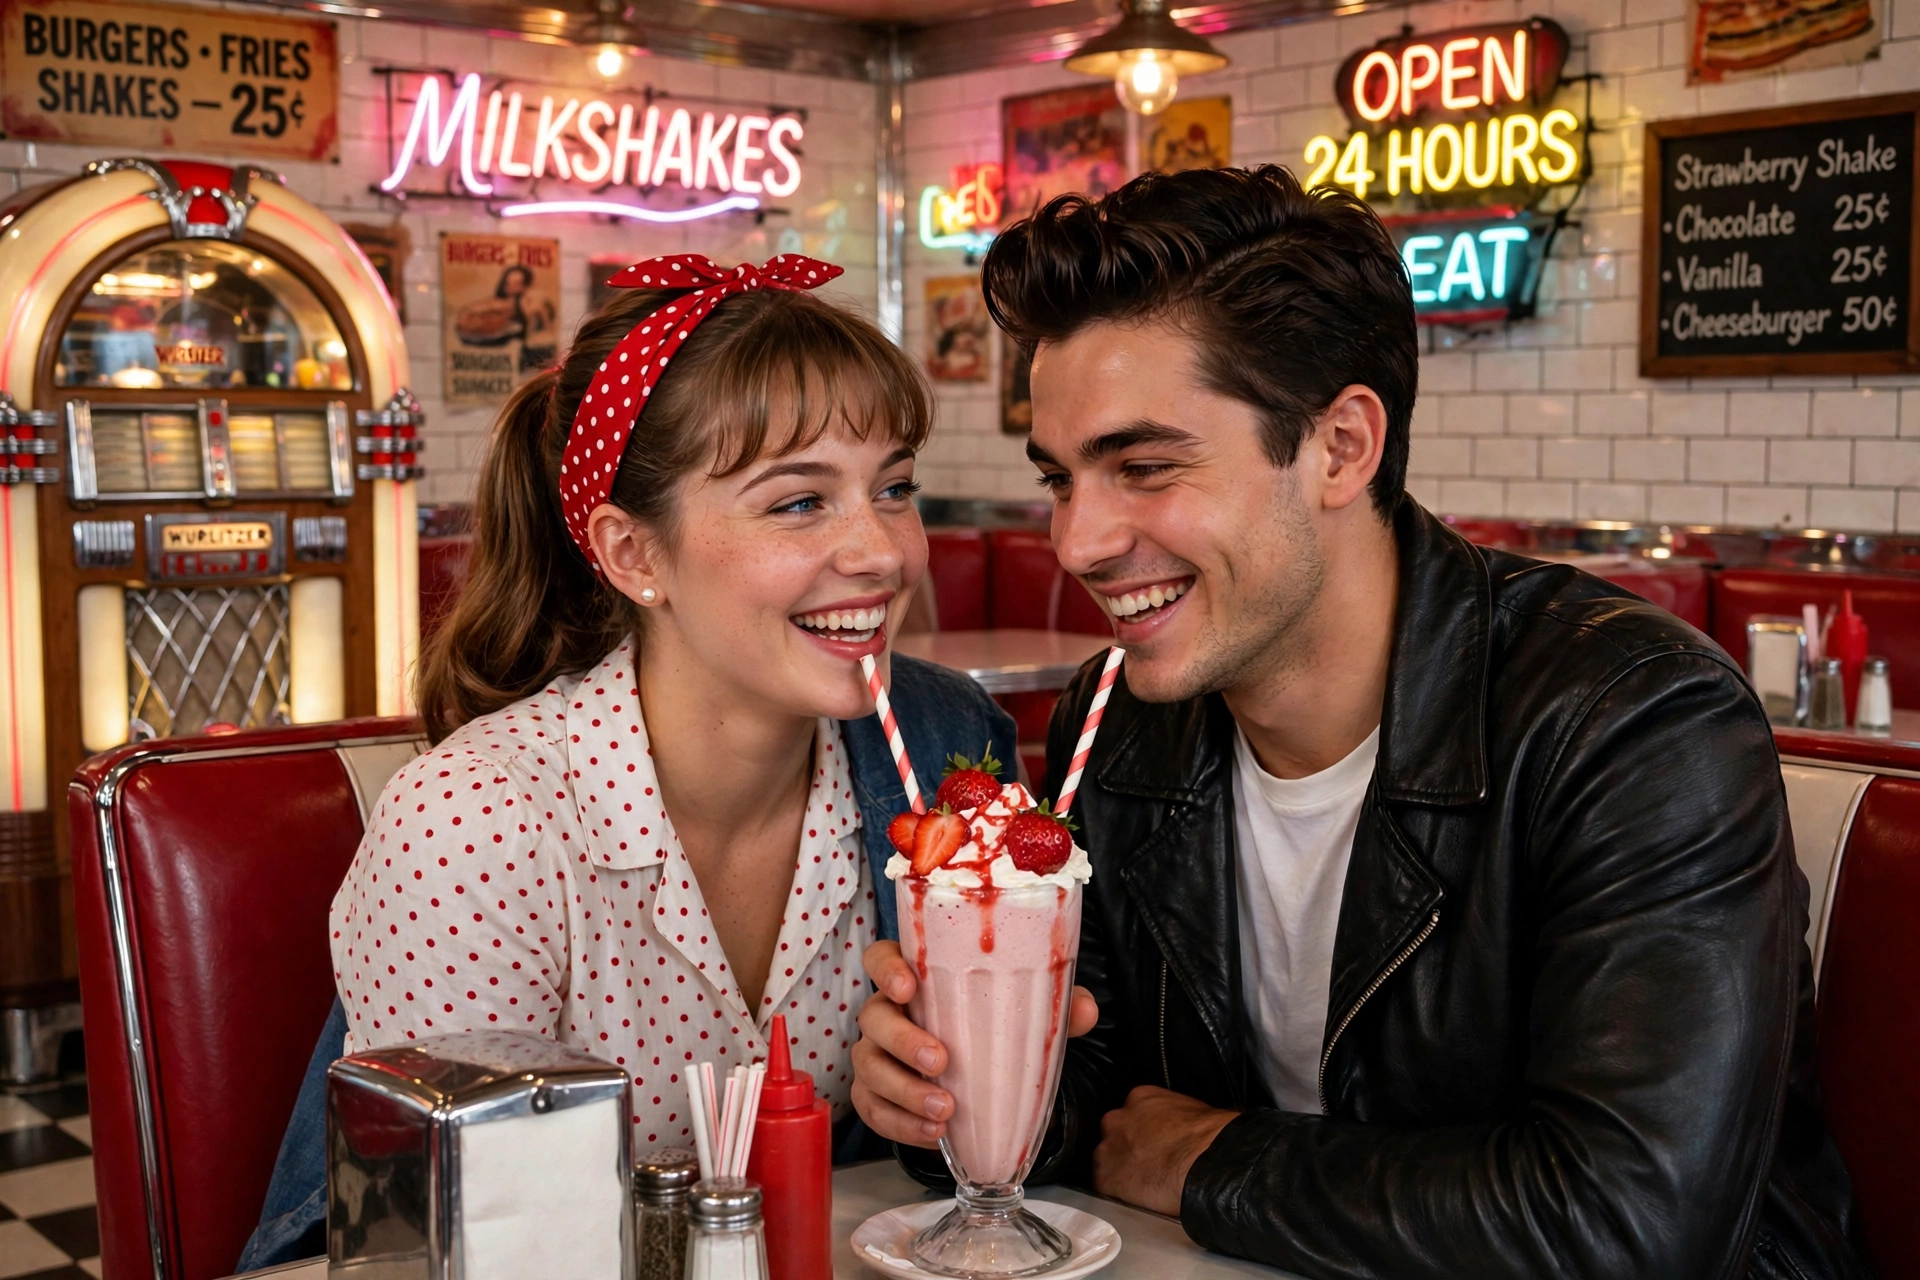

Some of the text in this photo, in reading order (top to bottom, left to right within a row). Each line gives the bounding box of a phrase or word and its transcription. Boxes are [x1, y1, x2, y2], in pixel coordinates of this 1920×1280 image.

[24, 13, 311, 81] BURGERS FRIES
[1353, 29, 1527, 122] OPEN
[37, 68, 180, 120] SHAKES
[231, 83, 305, 137] 25¢
[381, 73, 804, 197] MILKSHAKES
[1304, 109, 1578, 200] 24 HOURS
[1674, 134, 1897, 192] Strawberry Shake
[1676, 192, 1890, 243] Chocolate 25¢
[1401, 226, 1530, 303] EAT
[1677, 245, 1888, 292] Vanilla 25¢
[1672, 295, 1898, 346] Cheeseburger 50¢
